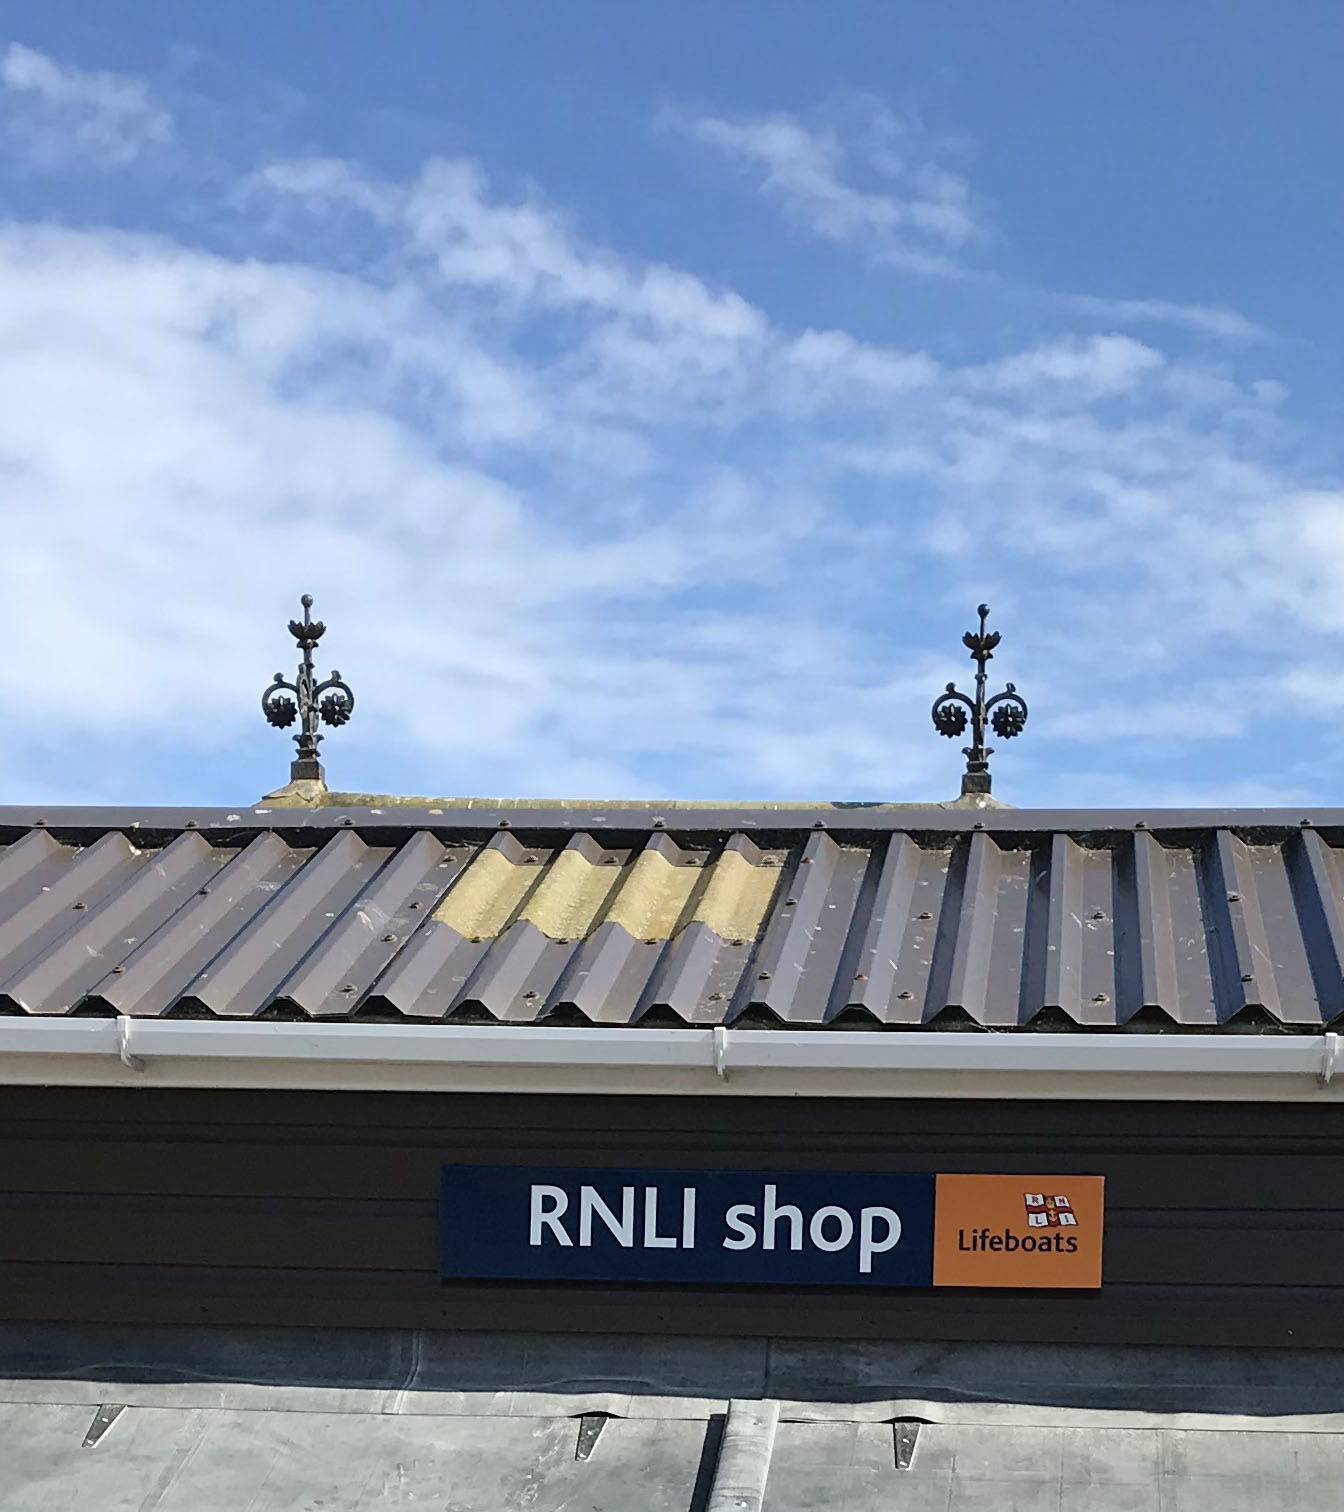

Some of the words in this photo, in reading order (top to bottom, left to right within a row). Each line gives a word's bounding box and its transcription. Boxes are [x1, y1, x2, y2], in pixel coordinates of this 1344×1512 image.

[529, 1183, 697, 1249] RNLI
[722, 1184, 902, 1273] shop
[958, 1228, 1078, 1253] Lifeboats
